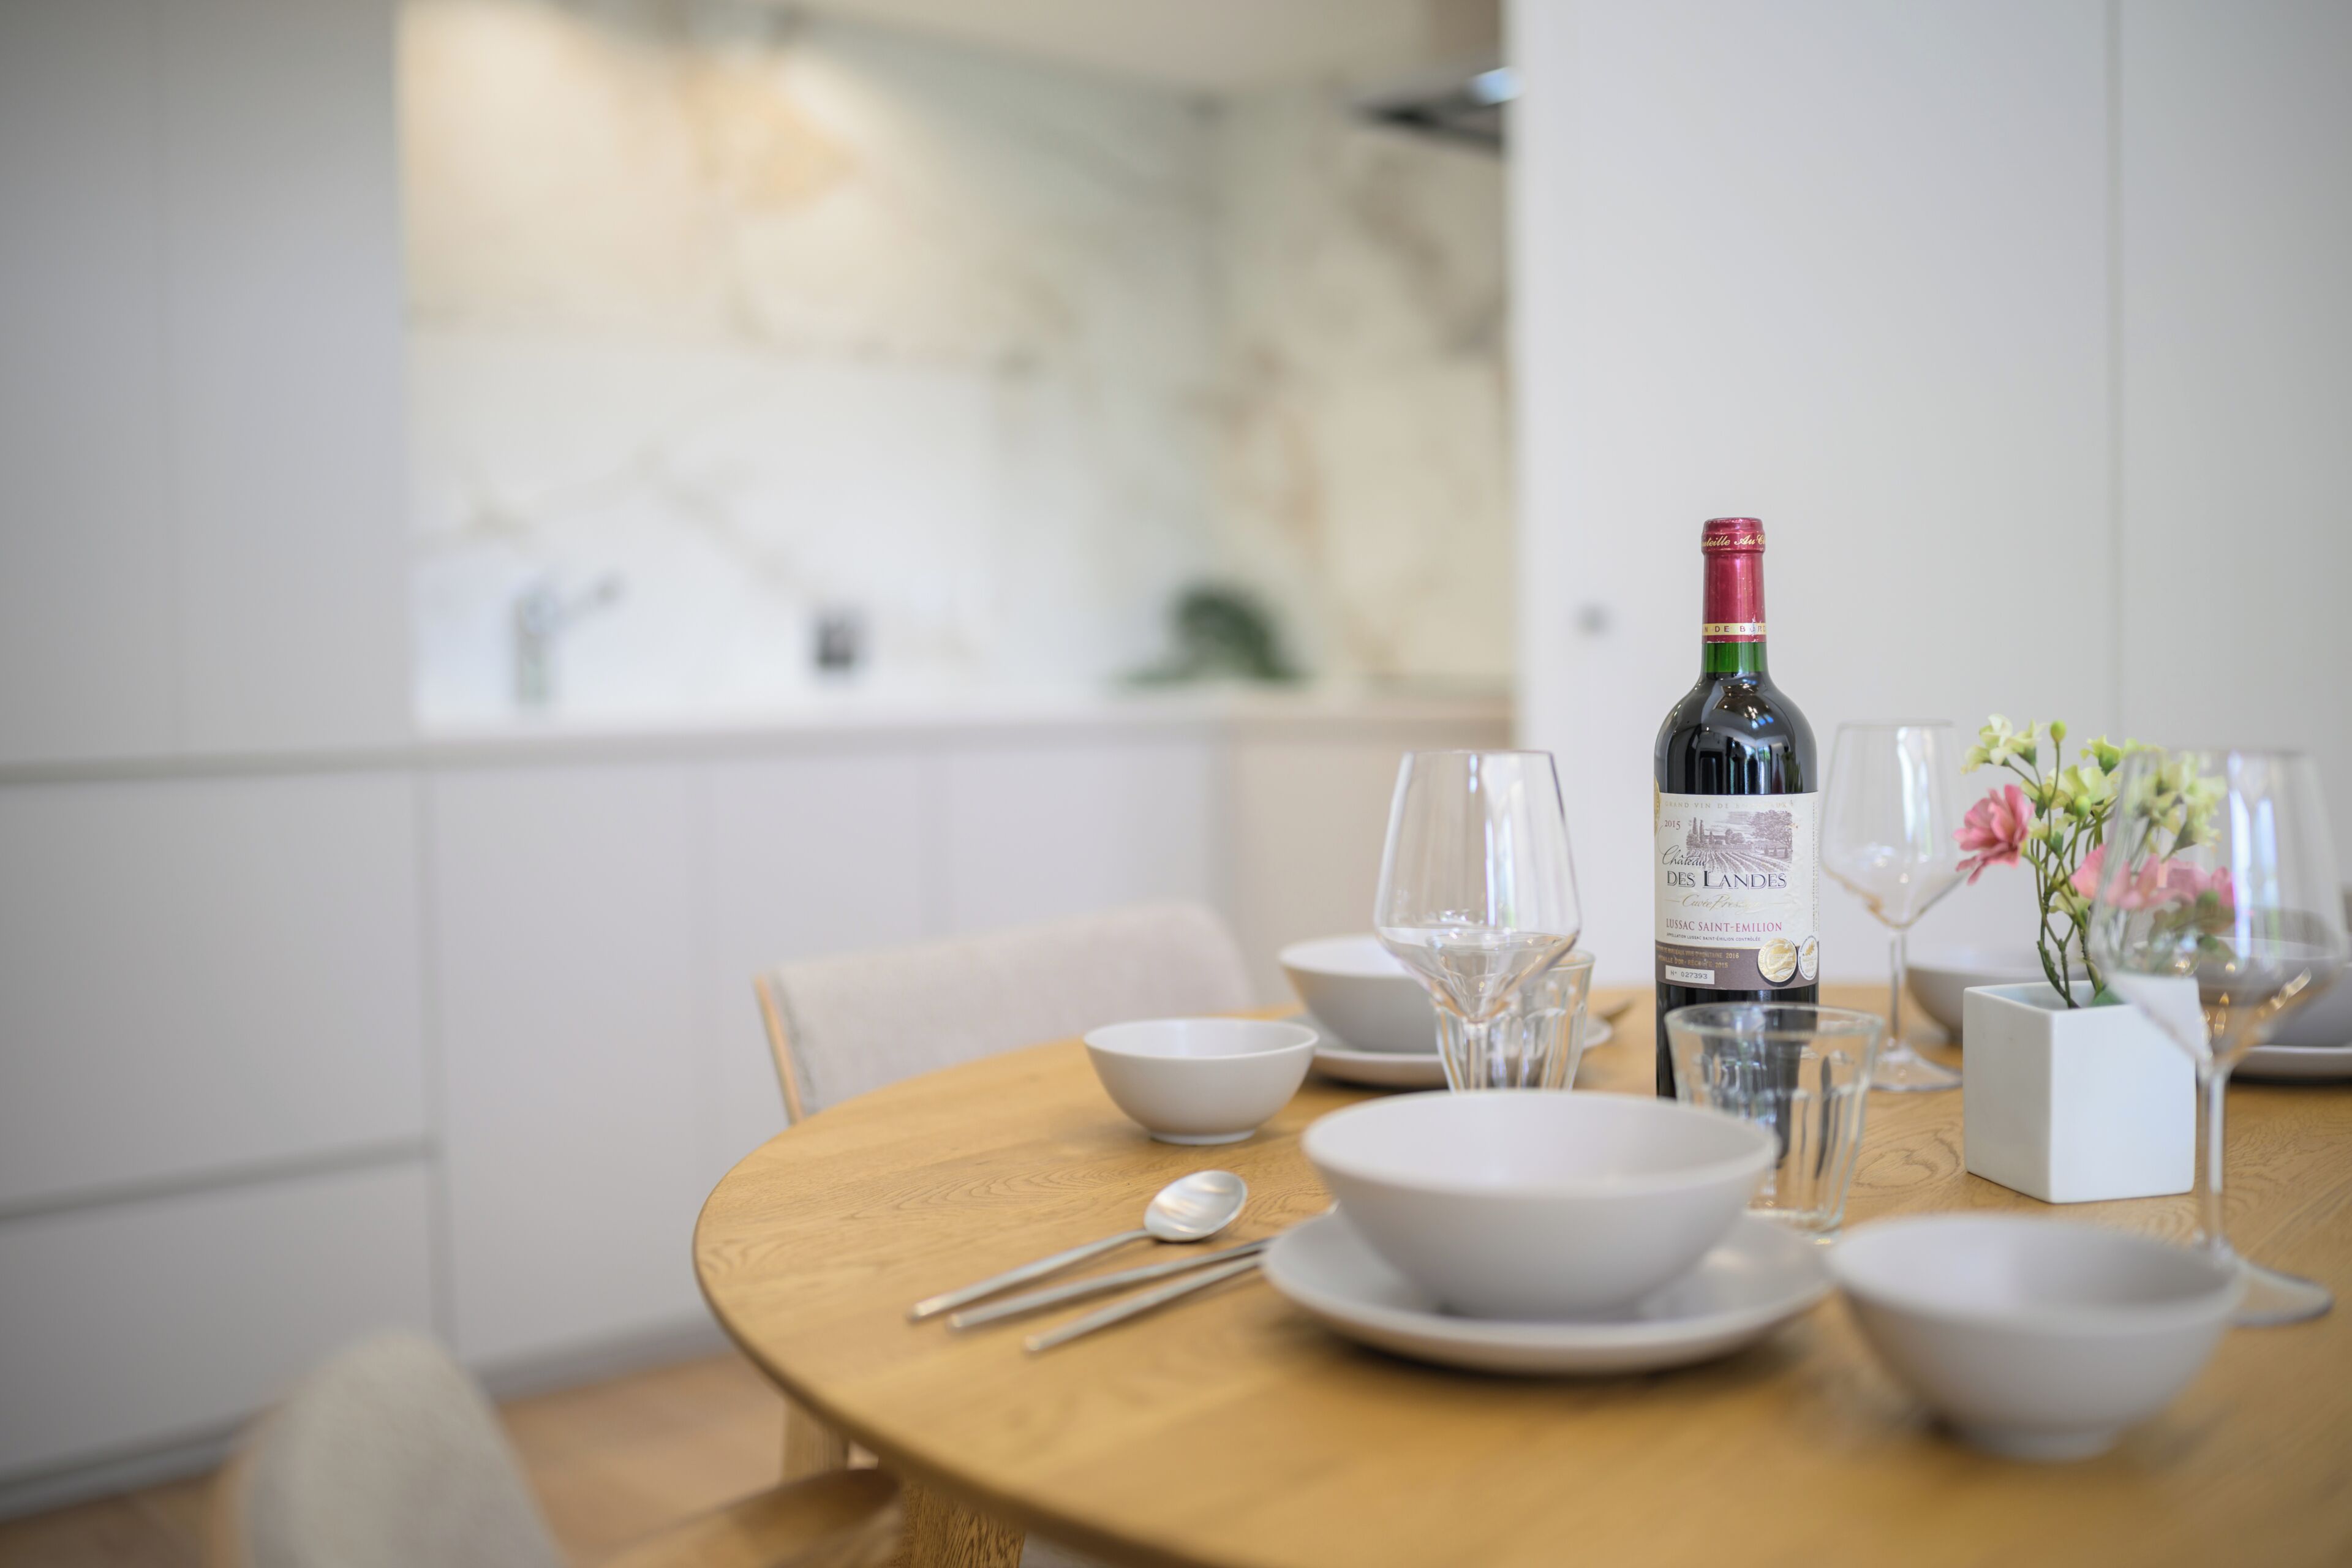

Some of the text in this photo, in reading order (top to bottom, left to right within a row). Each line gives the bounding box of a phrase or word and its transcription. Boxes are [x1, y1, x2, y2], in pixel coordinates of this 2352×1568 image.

[1734, 535, 1755, 545] Au
[1664, 820, 1681, 831] 2015
[1662, 845, 1707, 867] Château
[1667, 870, 1696, 888] DES
[1682, 894, 1711, 908] Cuvée
[1666, 918, 1782, 933] LUSSAC SAINT-EMILION
[1680, 970, 1708, 979] 027393
